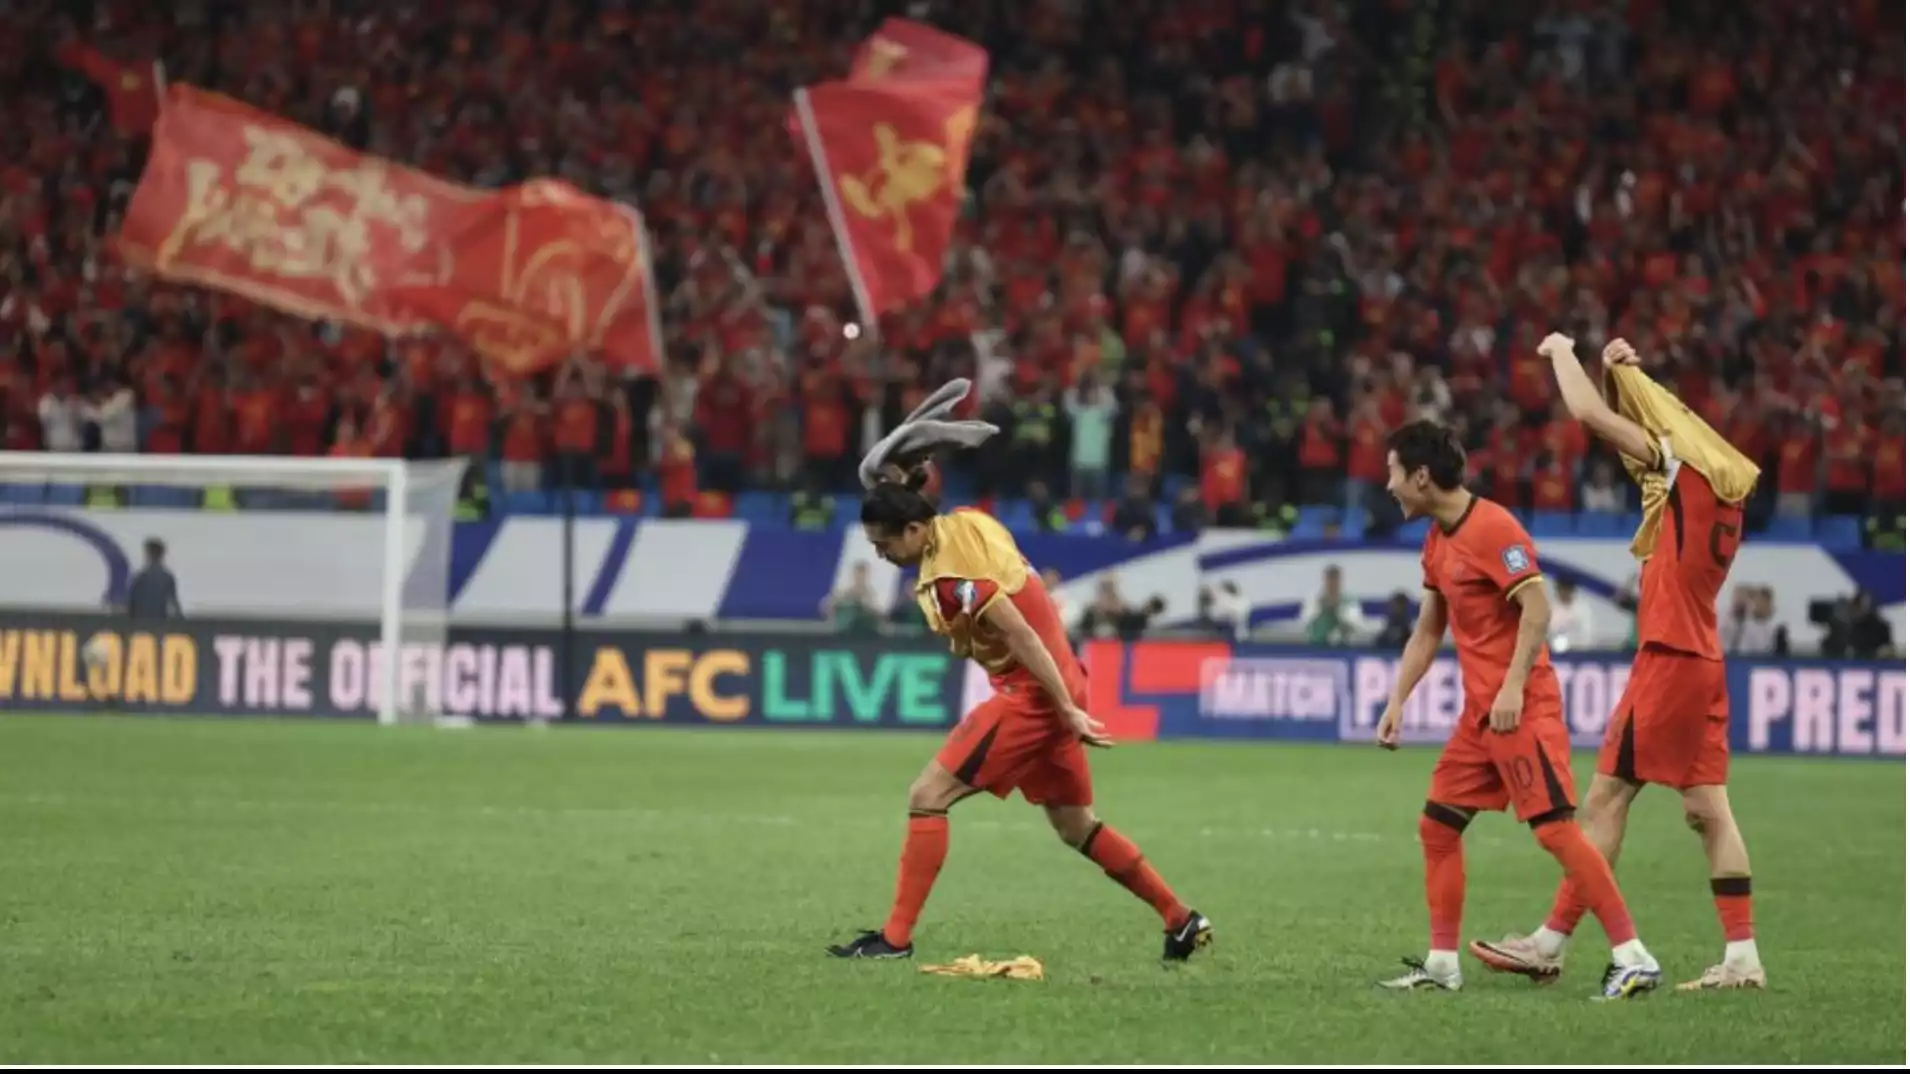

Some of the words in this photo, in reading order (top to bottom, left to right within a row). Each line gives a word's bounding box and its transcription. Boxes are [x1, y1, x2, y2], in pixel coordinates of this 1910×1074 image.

[213, 635, 314, 709] THE
[577, 646, 751, 720] AFC
[761, 649, 948, 722] LIVE
[1748, 667, 1906, 753] PRED
